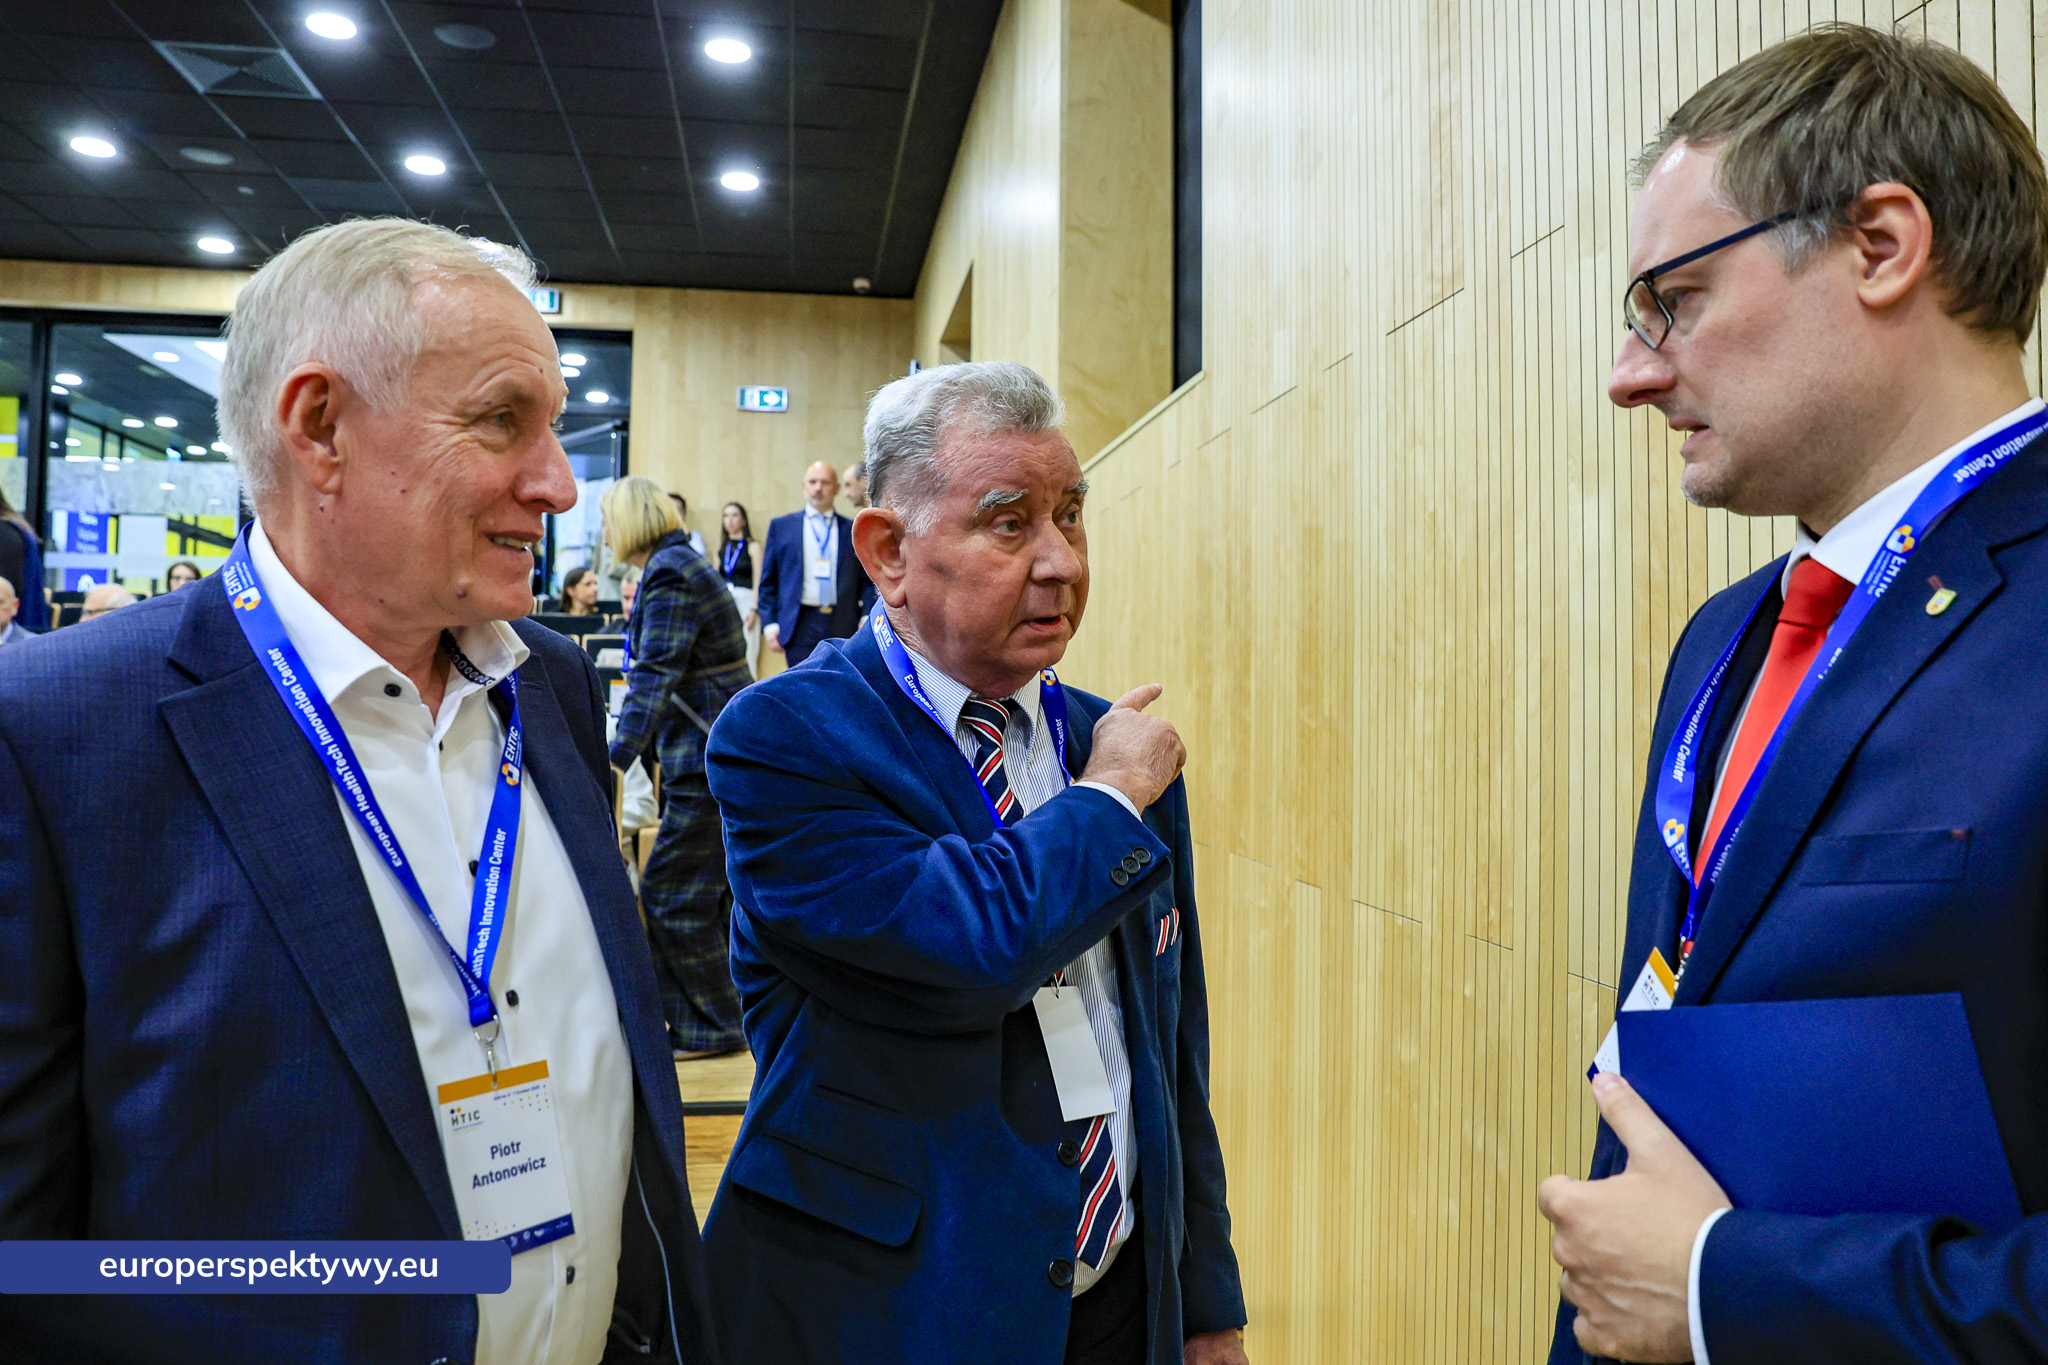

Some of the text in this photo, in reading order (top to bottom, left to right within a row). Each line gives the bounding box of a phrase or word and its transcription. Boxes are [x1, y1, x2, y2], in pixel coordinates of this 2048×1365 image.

[1953, 454, 1996, 483] Center
[904, 674, 933, 711] European
[1682, 686, 1713, 744] Innovation
[267, 648, 403, 867] European HealthTech Innovation Center
[505, 726, 519, 761] EHTIC
[1673, 744, 1690, 783] Center
[488, 828, 506, 865] Center
[479, 866, 501, 926] Innovation
[451, 1110, 481, 1126] HTIC
[490, 1140, 521, 1160] Piotr
[472, 1157, 547, 1189] Antonowicz
